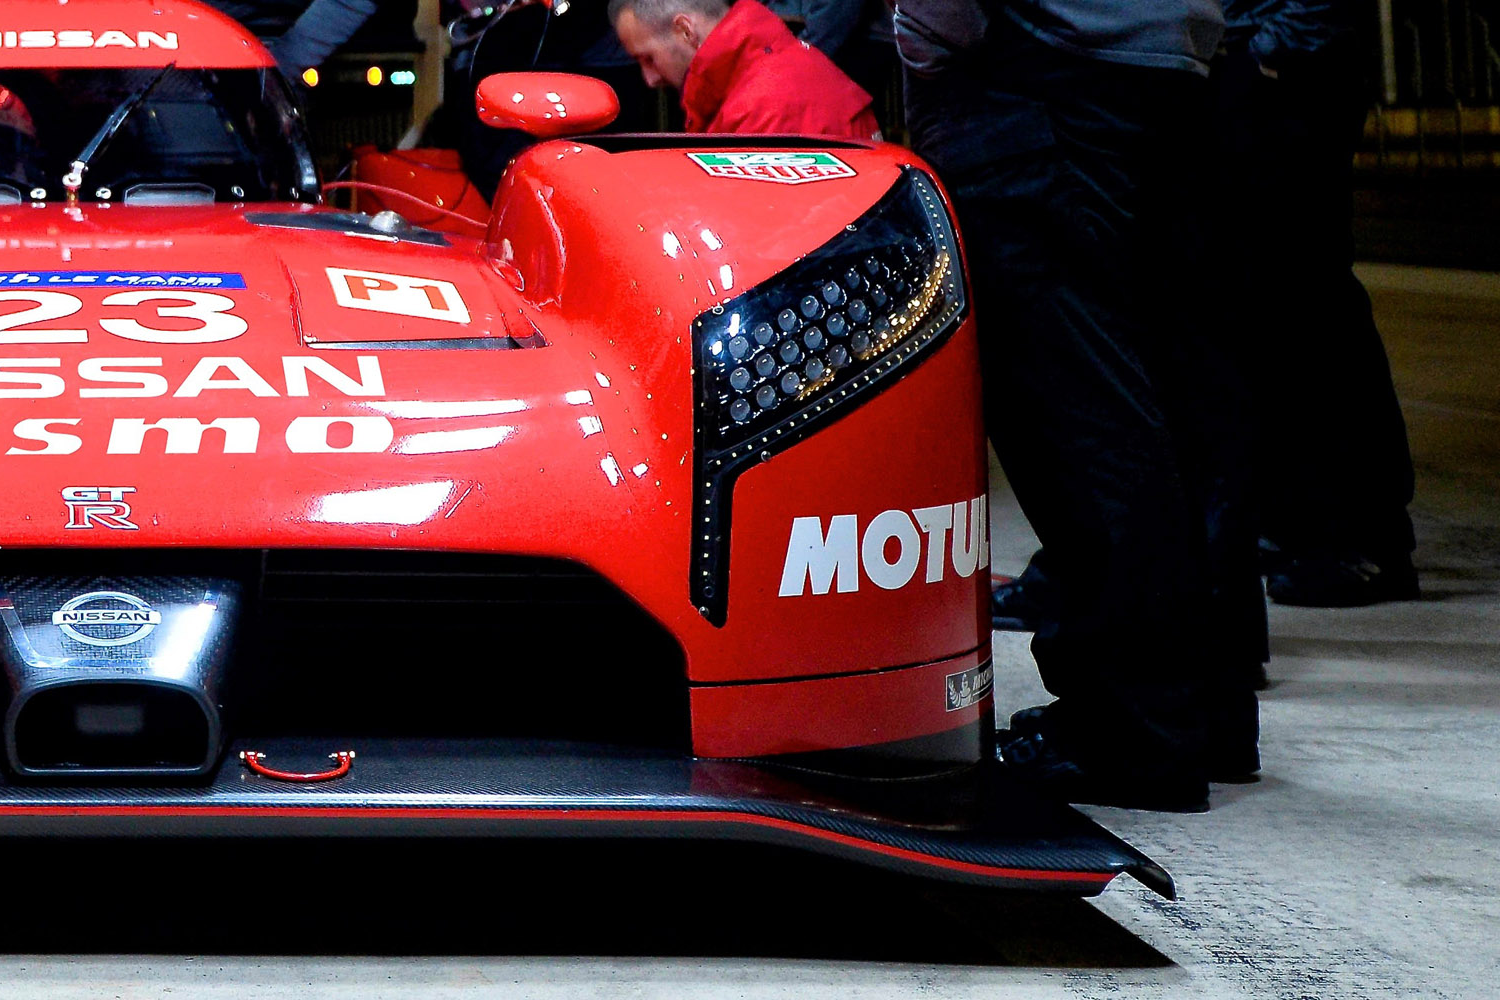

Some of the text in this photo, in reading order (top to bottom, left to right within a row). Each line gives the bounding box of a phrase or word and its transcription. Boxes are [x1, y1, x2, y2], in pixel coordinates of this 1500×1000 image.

[712, 166, 850, 181] HEUER
[49, 275, 99, 283] LE
[344, 275, 450, 311] P1
[61, 486, 137, 501] GT
[64, 501, 140, 530] R
[778, 493, 989, 597] MOTUL
[62, 612, 150, 622] NISSAN
